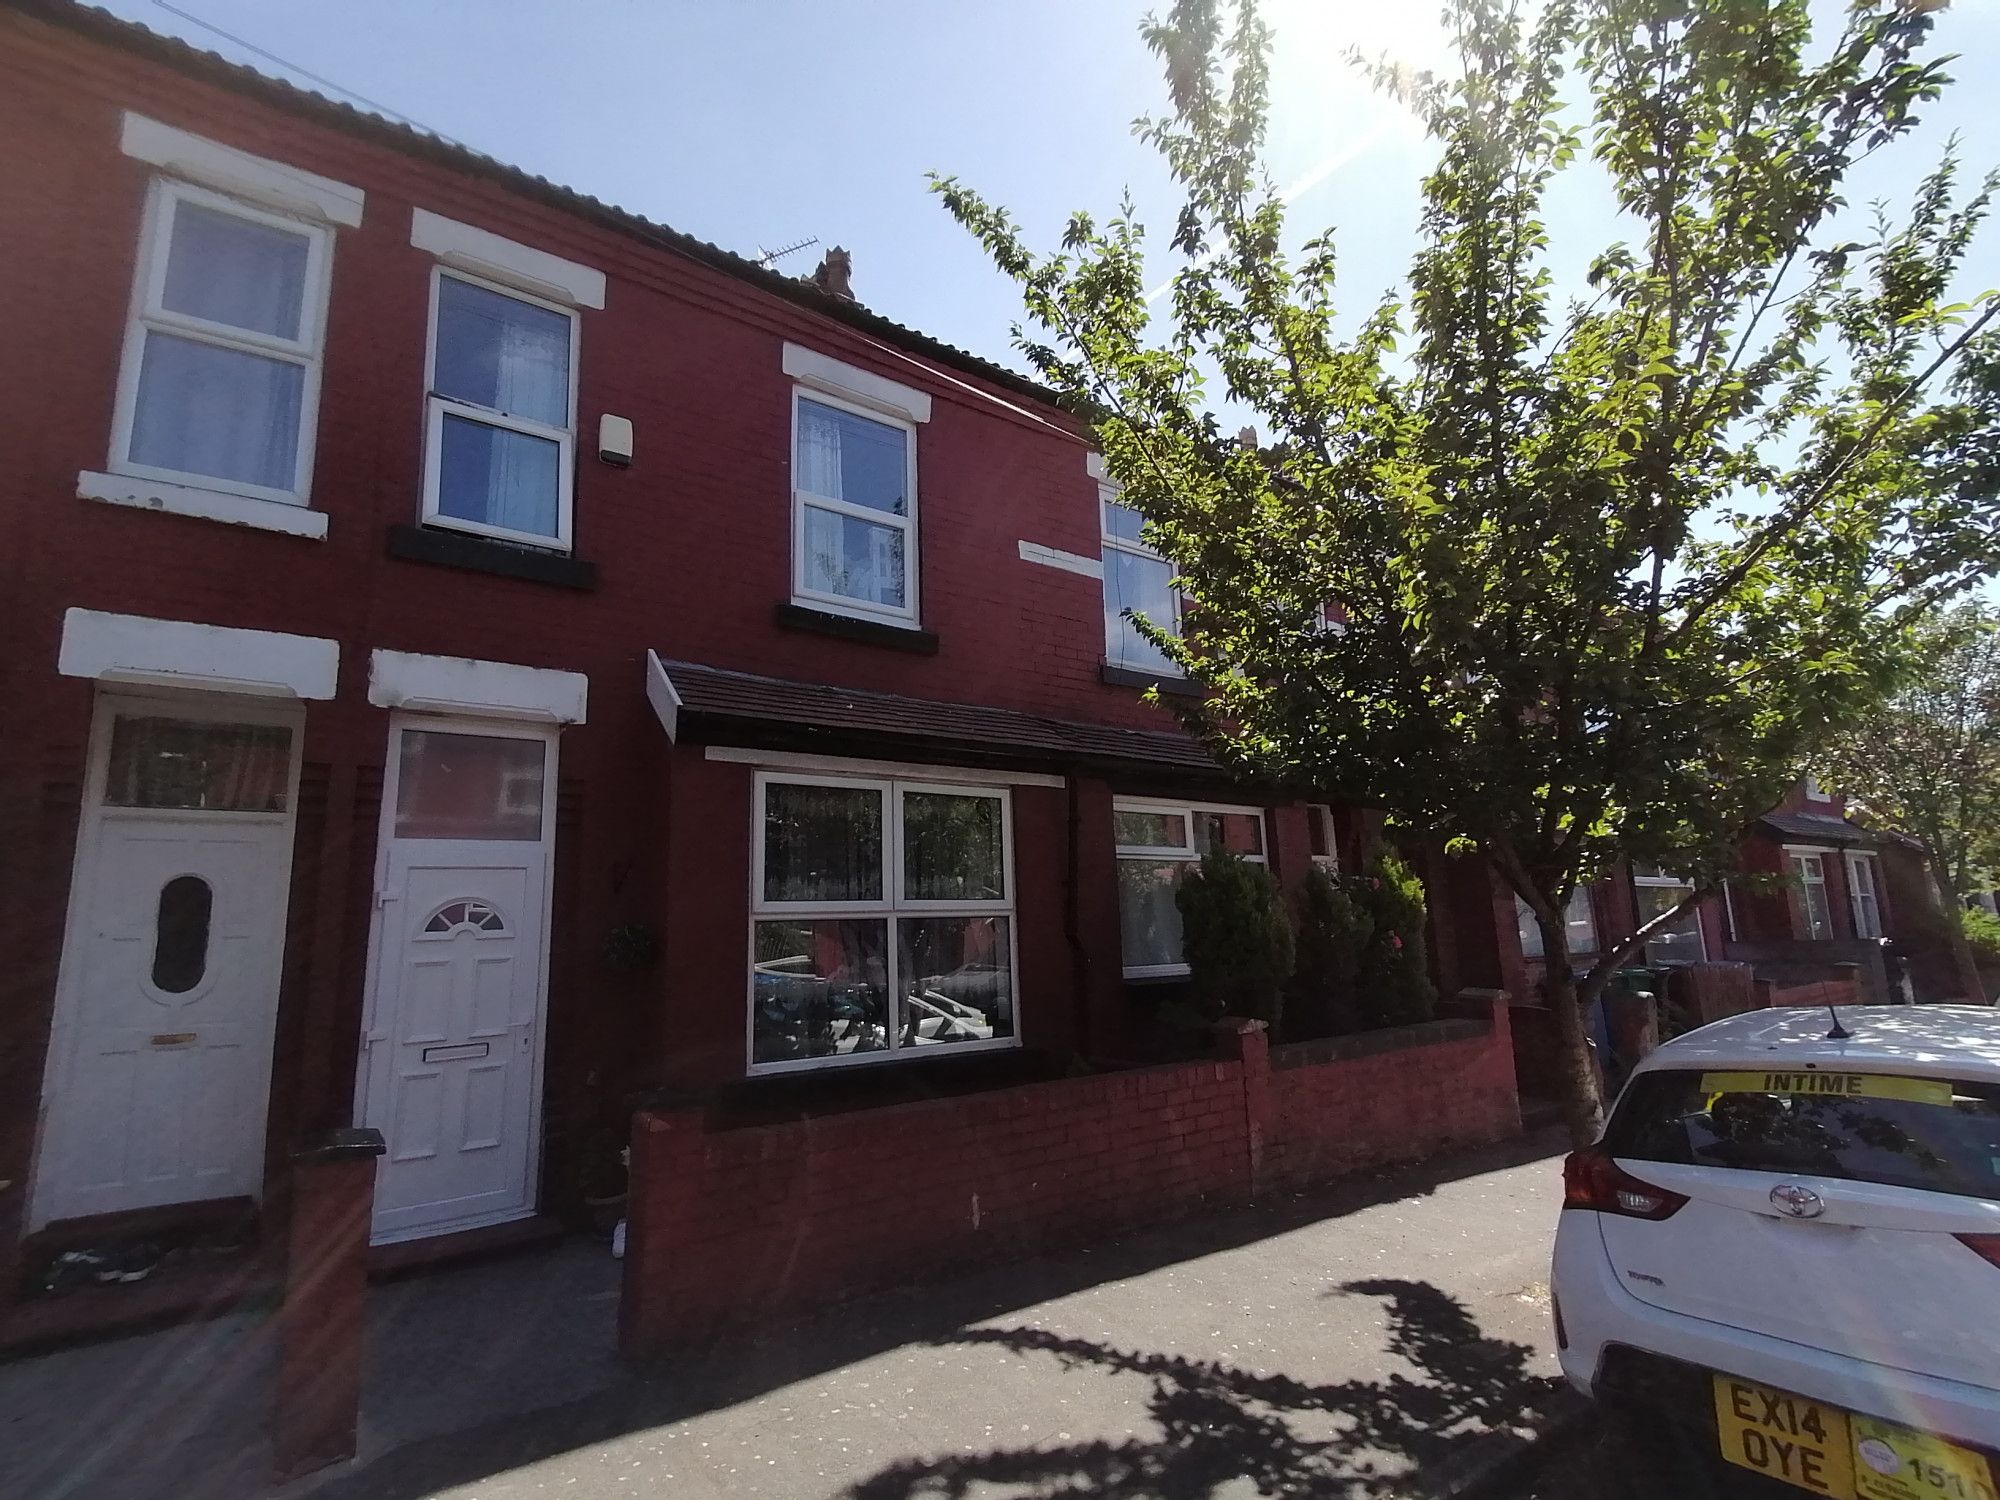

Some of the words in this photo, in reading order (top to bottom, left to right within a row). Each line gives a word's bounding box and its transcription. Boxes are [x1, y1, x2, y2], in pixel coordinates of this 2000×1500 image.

[1764, 1074, 1862, 1093] INTIME
[1731, 1383, 1827, 1444] EX14
[1742, 1428, 1829, 1490] OYE
